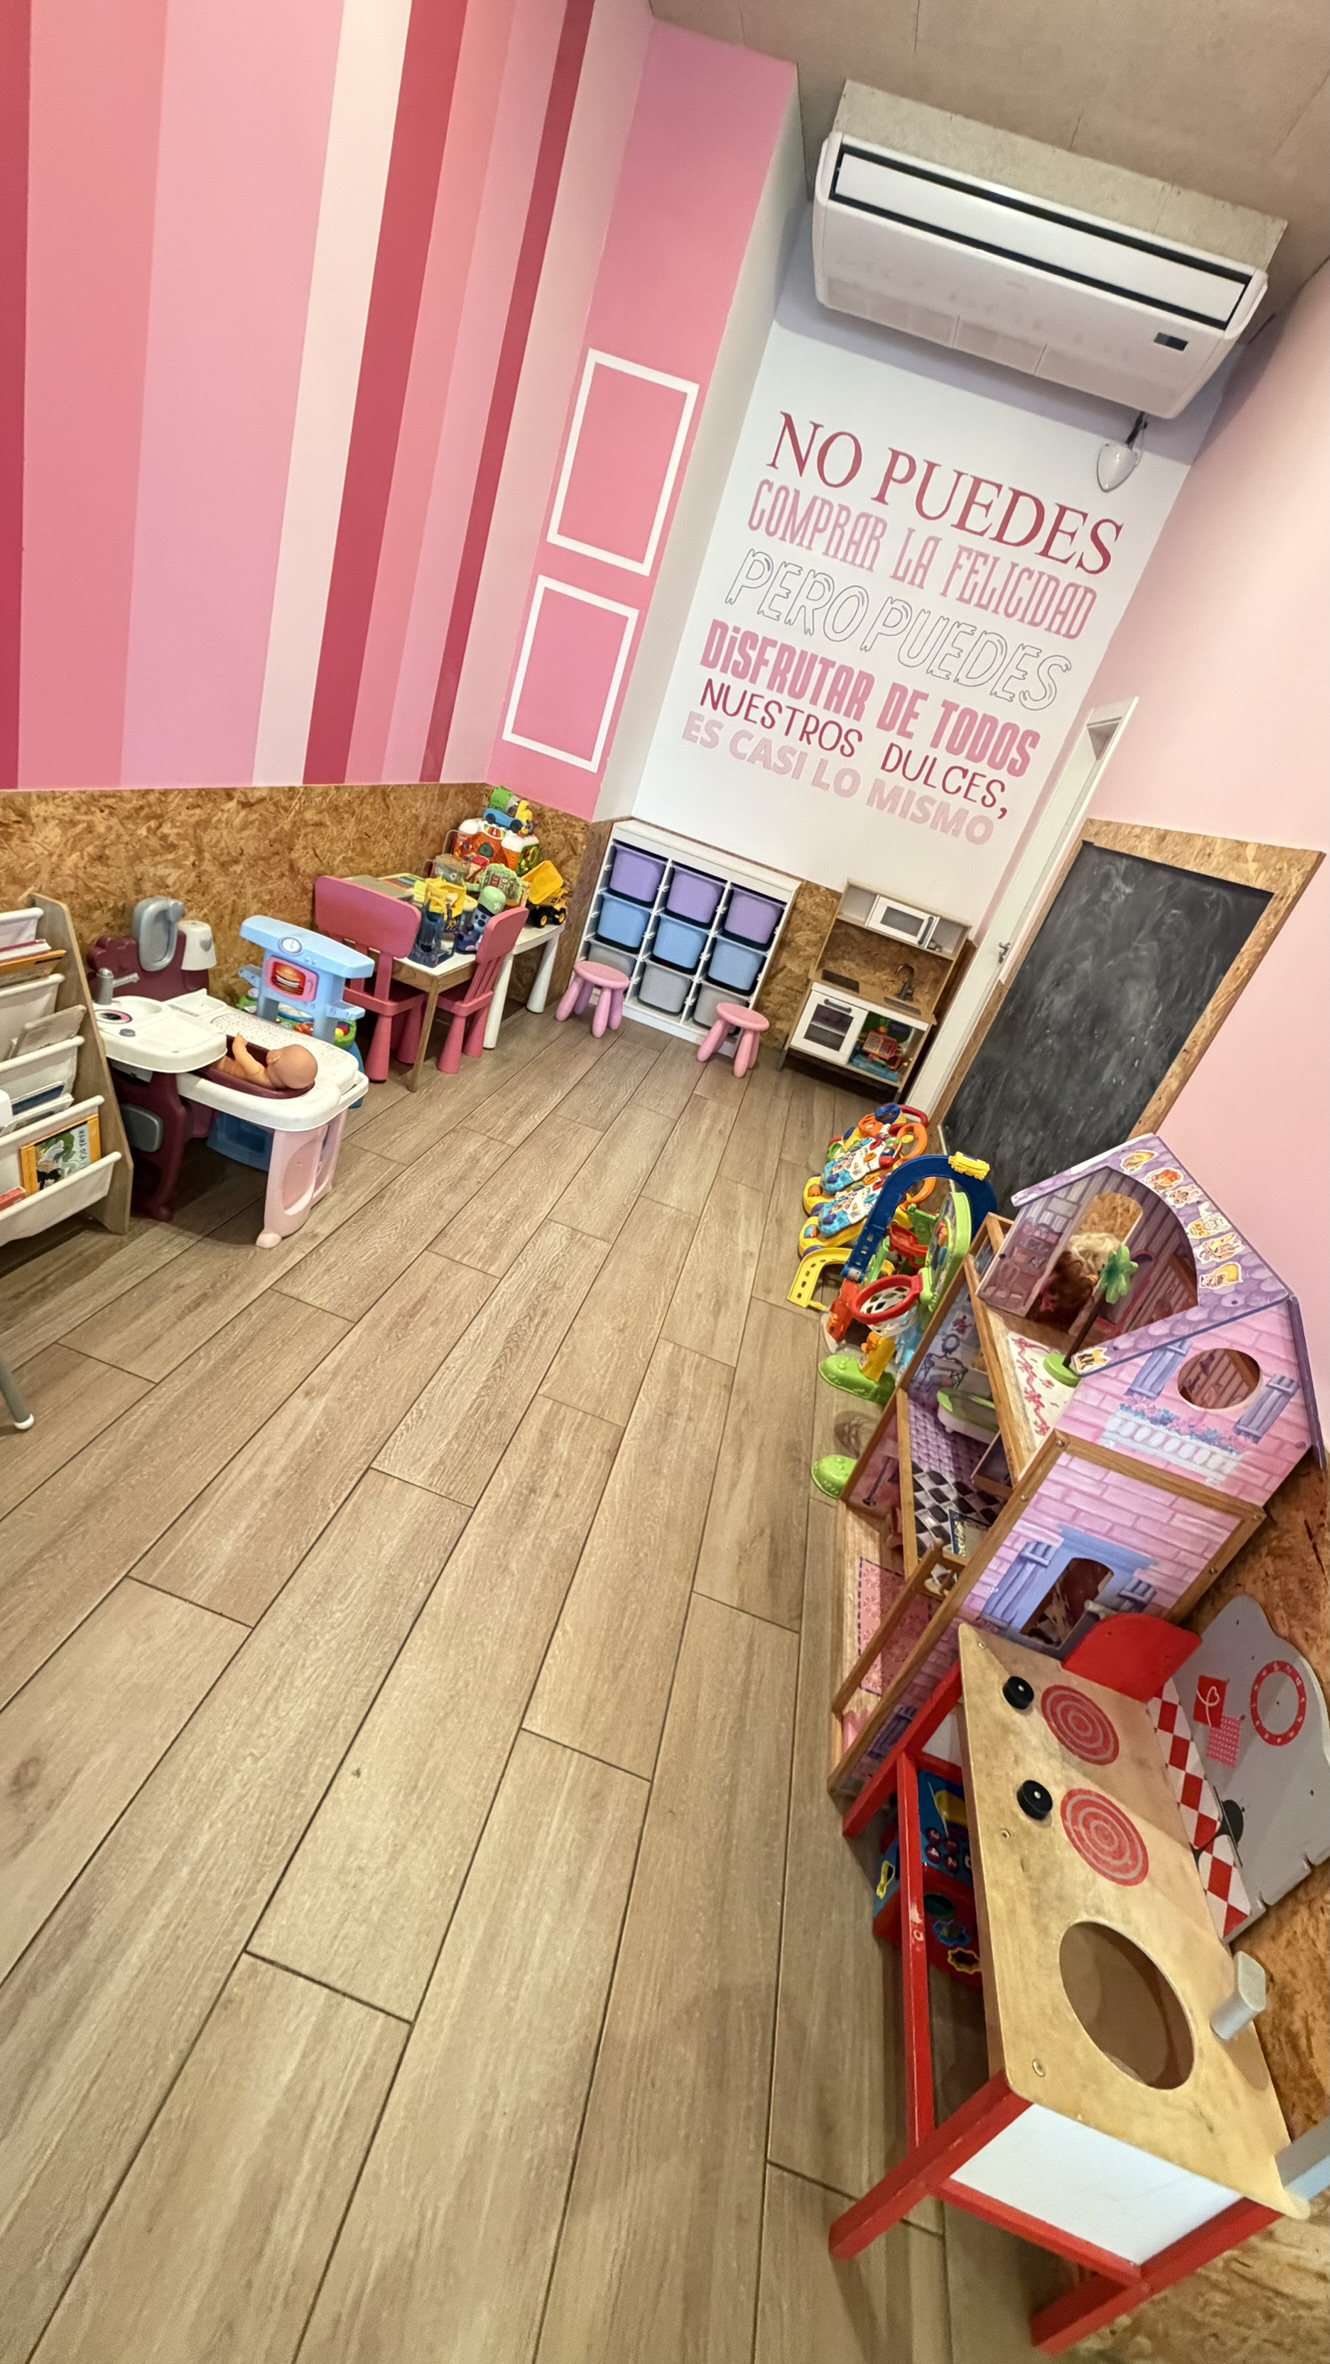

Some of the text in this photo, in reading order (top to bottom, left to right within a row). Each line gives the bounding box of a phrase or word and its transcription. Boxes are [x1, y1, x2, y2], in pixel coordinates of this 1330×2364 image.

[747, 478, 1097, 640] COMPRAR LA FELICIDAD
[766, 411, 1125, 575] NO PUEDES
[725, 549, 1072, 711] PERO PUEDES
[681, 711, 995, 846] ES CASI LO MISMO
[700, 678, 1008, 820] NUESTROS DULCES,
[876, 681, 930, 740] DE
[929, 700, 1041, 778] TODOS
